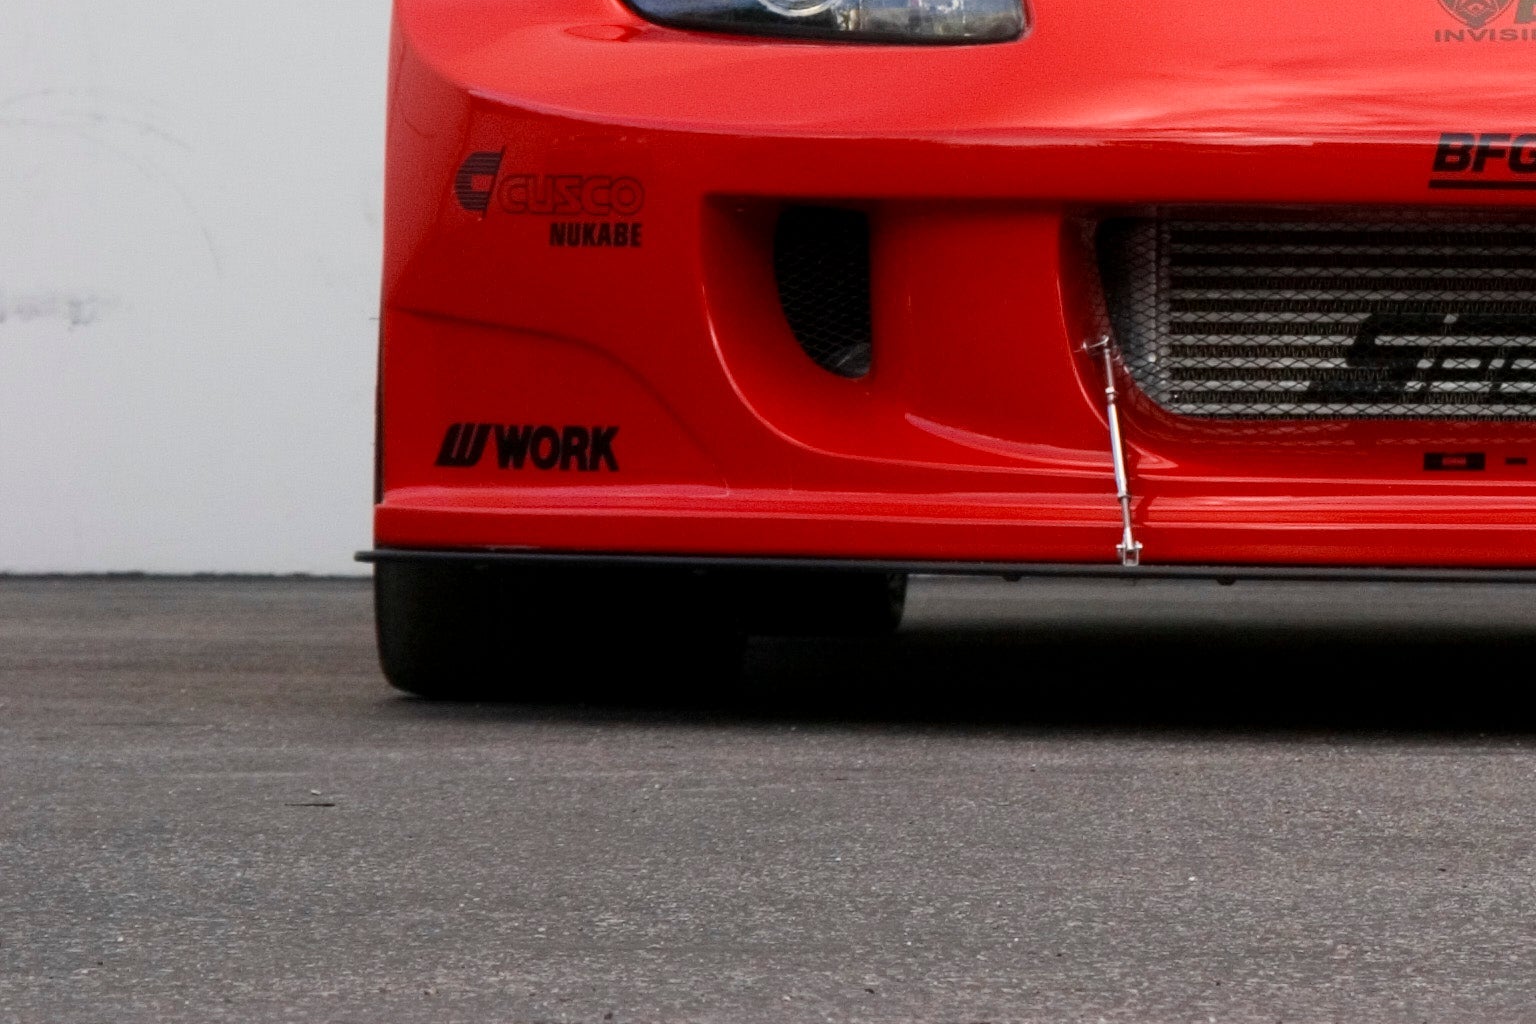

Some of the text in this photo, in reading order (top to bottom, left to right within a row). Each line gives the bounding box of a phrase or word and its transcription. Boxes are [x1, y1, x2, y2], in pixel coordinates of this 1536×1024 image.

[499, 173, 646, 217] CUSCO
[549, 222, 643, 248] NUKABE
[495, 423, 620, 472] WORK
